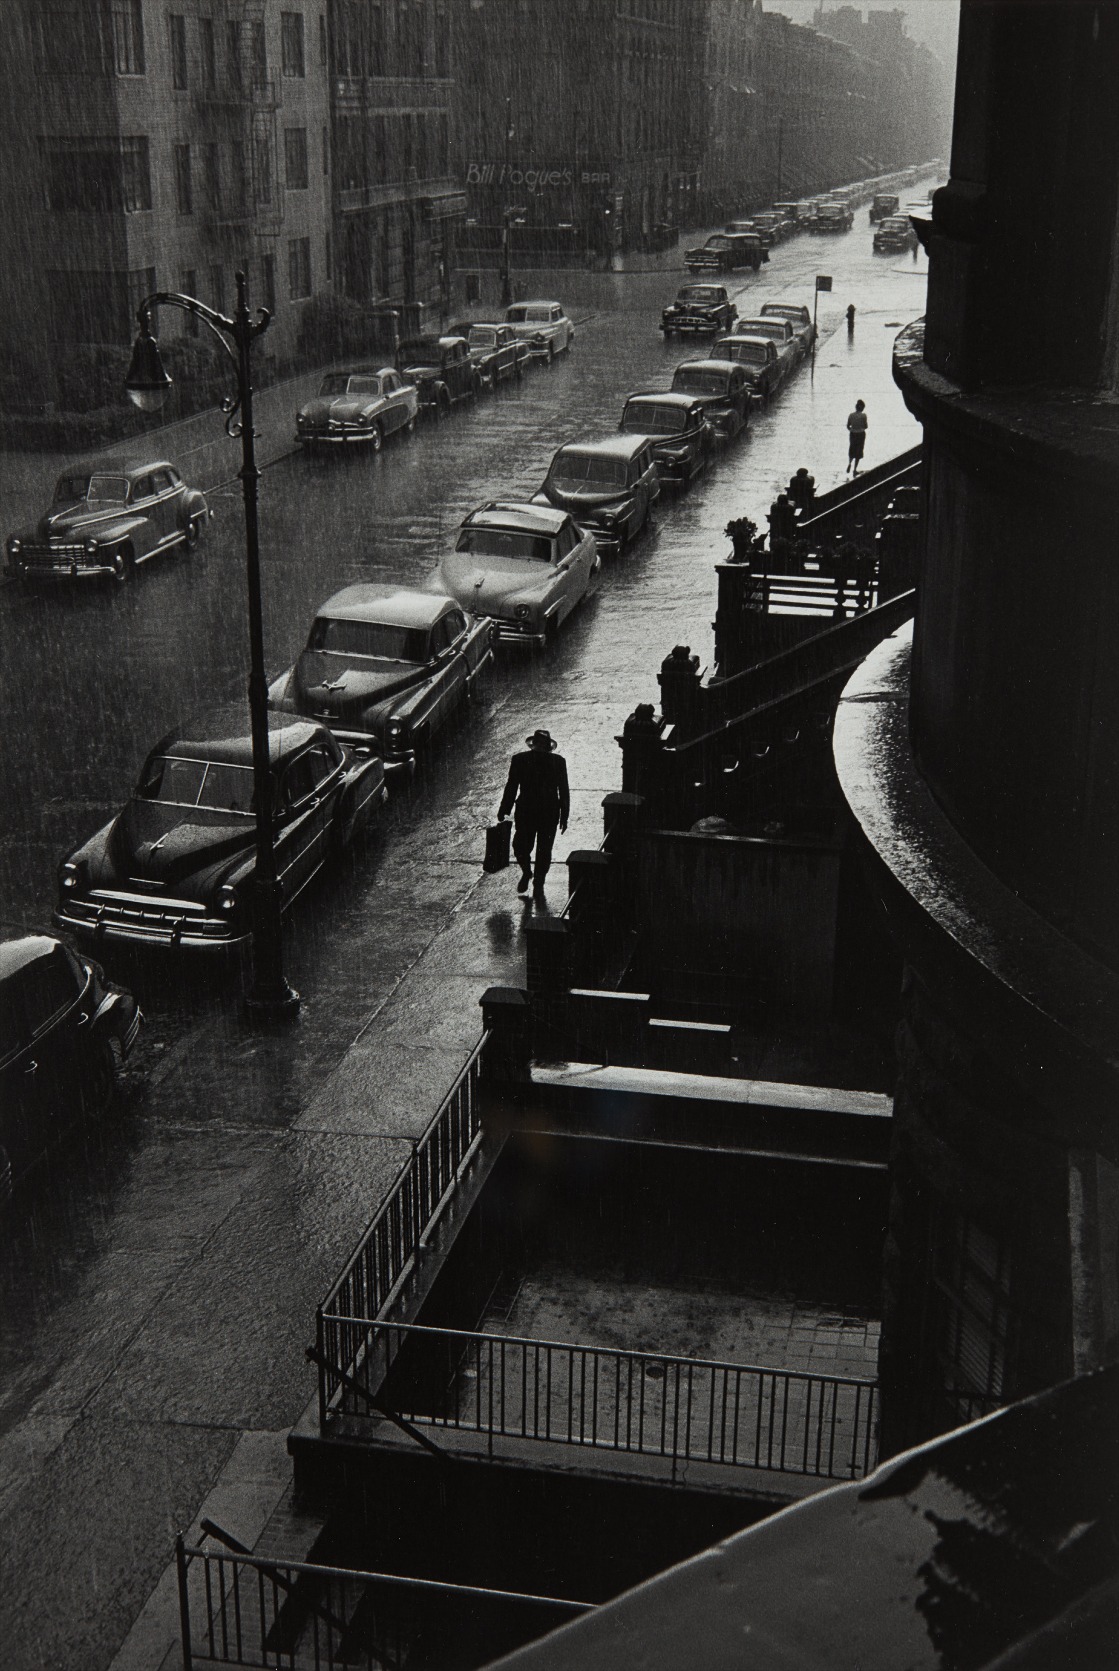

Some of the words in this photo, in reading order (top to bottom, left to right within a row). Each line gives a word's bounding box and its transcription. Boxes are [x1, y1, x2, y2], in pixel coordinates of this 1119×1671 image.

[466, 163, 494, 184] Bill
[500, 164, 573, 192] Pogue's
[581, 172, 611, 184] BAR
